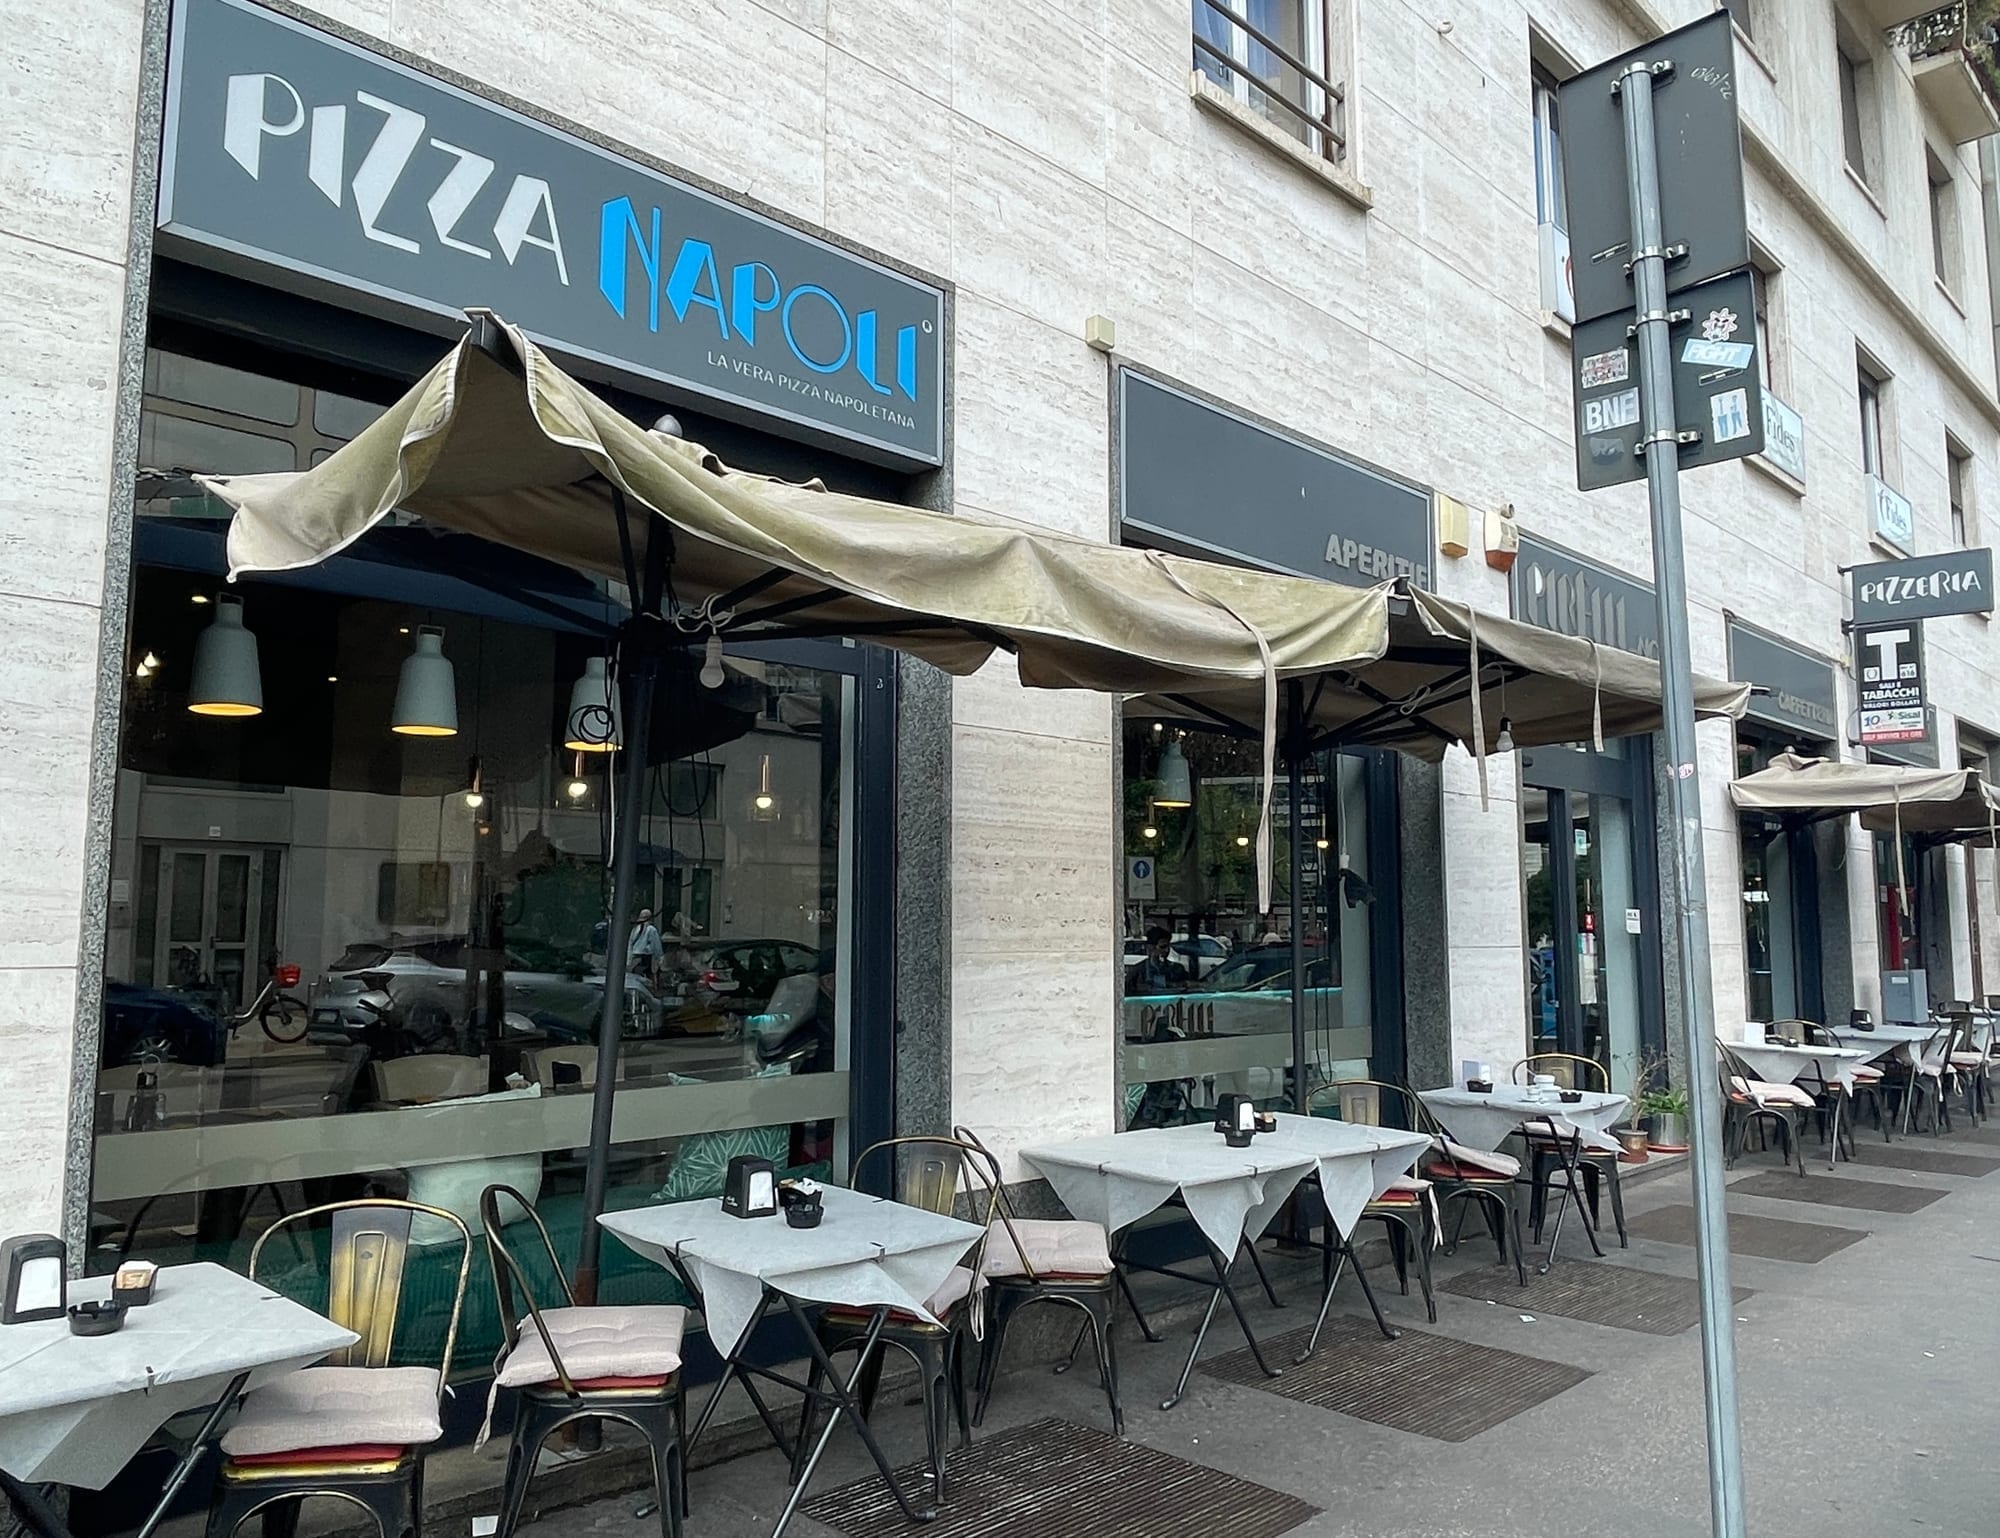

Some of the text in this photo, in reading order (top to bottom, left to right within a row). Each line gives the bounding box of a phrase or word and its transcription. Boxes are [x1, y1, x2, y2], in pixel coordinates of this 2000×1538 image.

[223, 72, 917, 402] PIZZA NAPOLI
[708, 351, 916, 430] LA VERA PIZZA NAPOLETANA
[1766, 404, 1796, 451] Fides
[1860, 569, 1982, 605] PIZZERIA
[1866, 629, 1910, 680] T
[1862, 687, 1920, 701] TABACCHI
